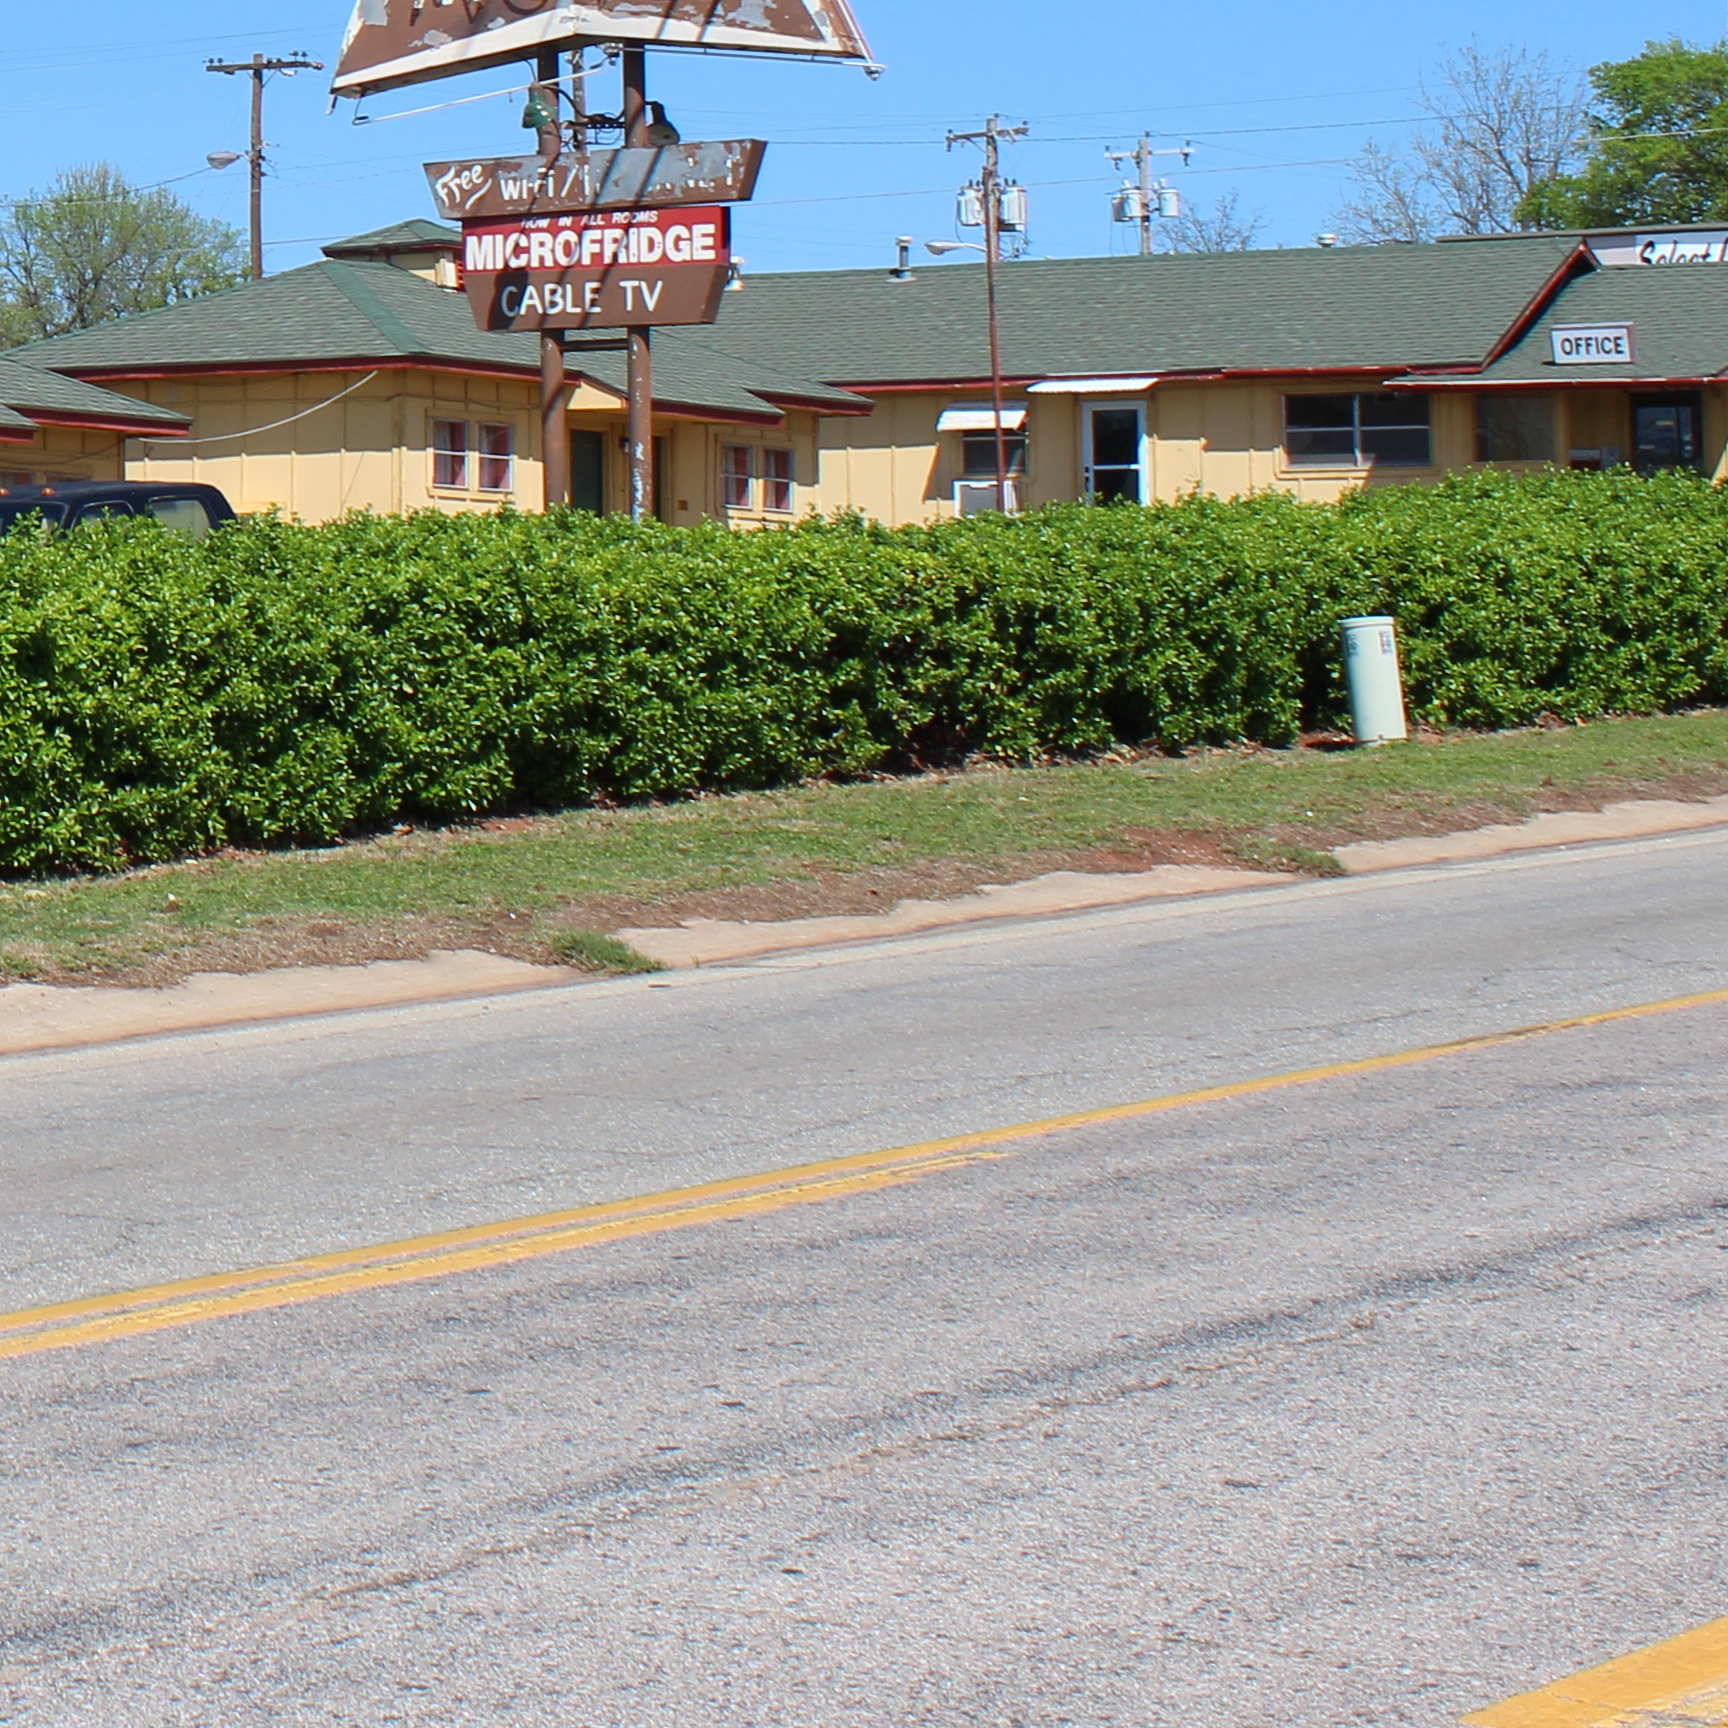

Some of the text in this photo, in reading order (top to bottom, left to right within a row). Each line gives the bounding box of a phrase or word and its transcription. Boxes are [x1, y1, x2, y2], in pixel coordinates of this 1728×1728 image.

[434, 164, 485, 208] Free
[558, 215, 573, 227] IN
[580, 214, 606, 226] ALL
[611, 210, 659, 224] ROOMS
[465, 223, 717, 271] MICROFRIDGE
[500, 279, 664, 318] CABLE TV
[1560, 336, 1625, 356] OFFICE
